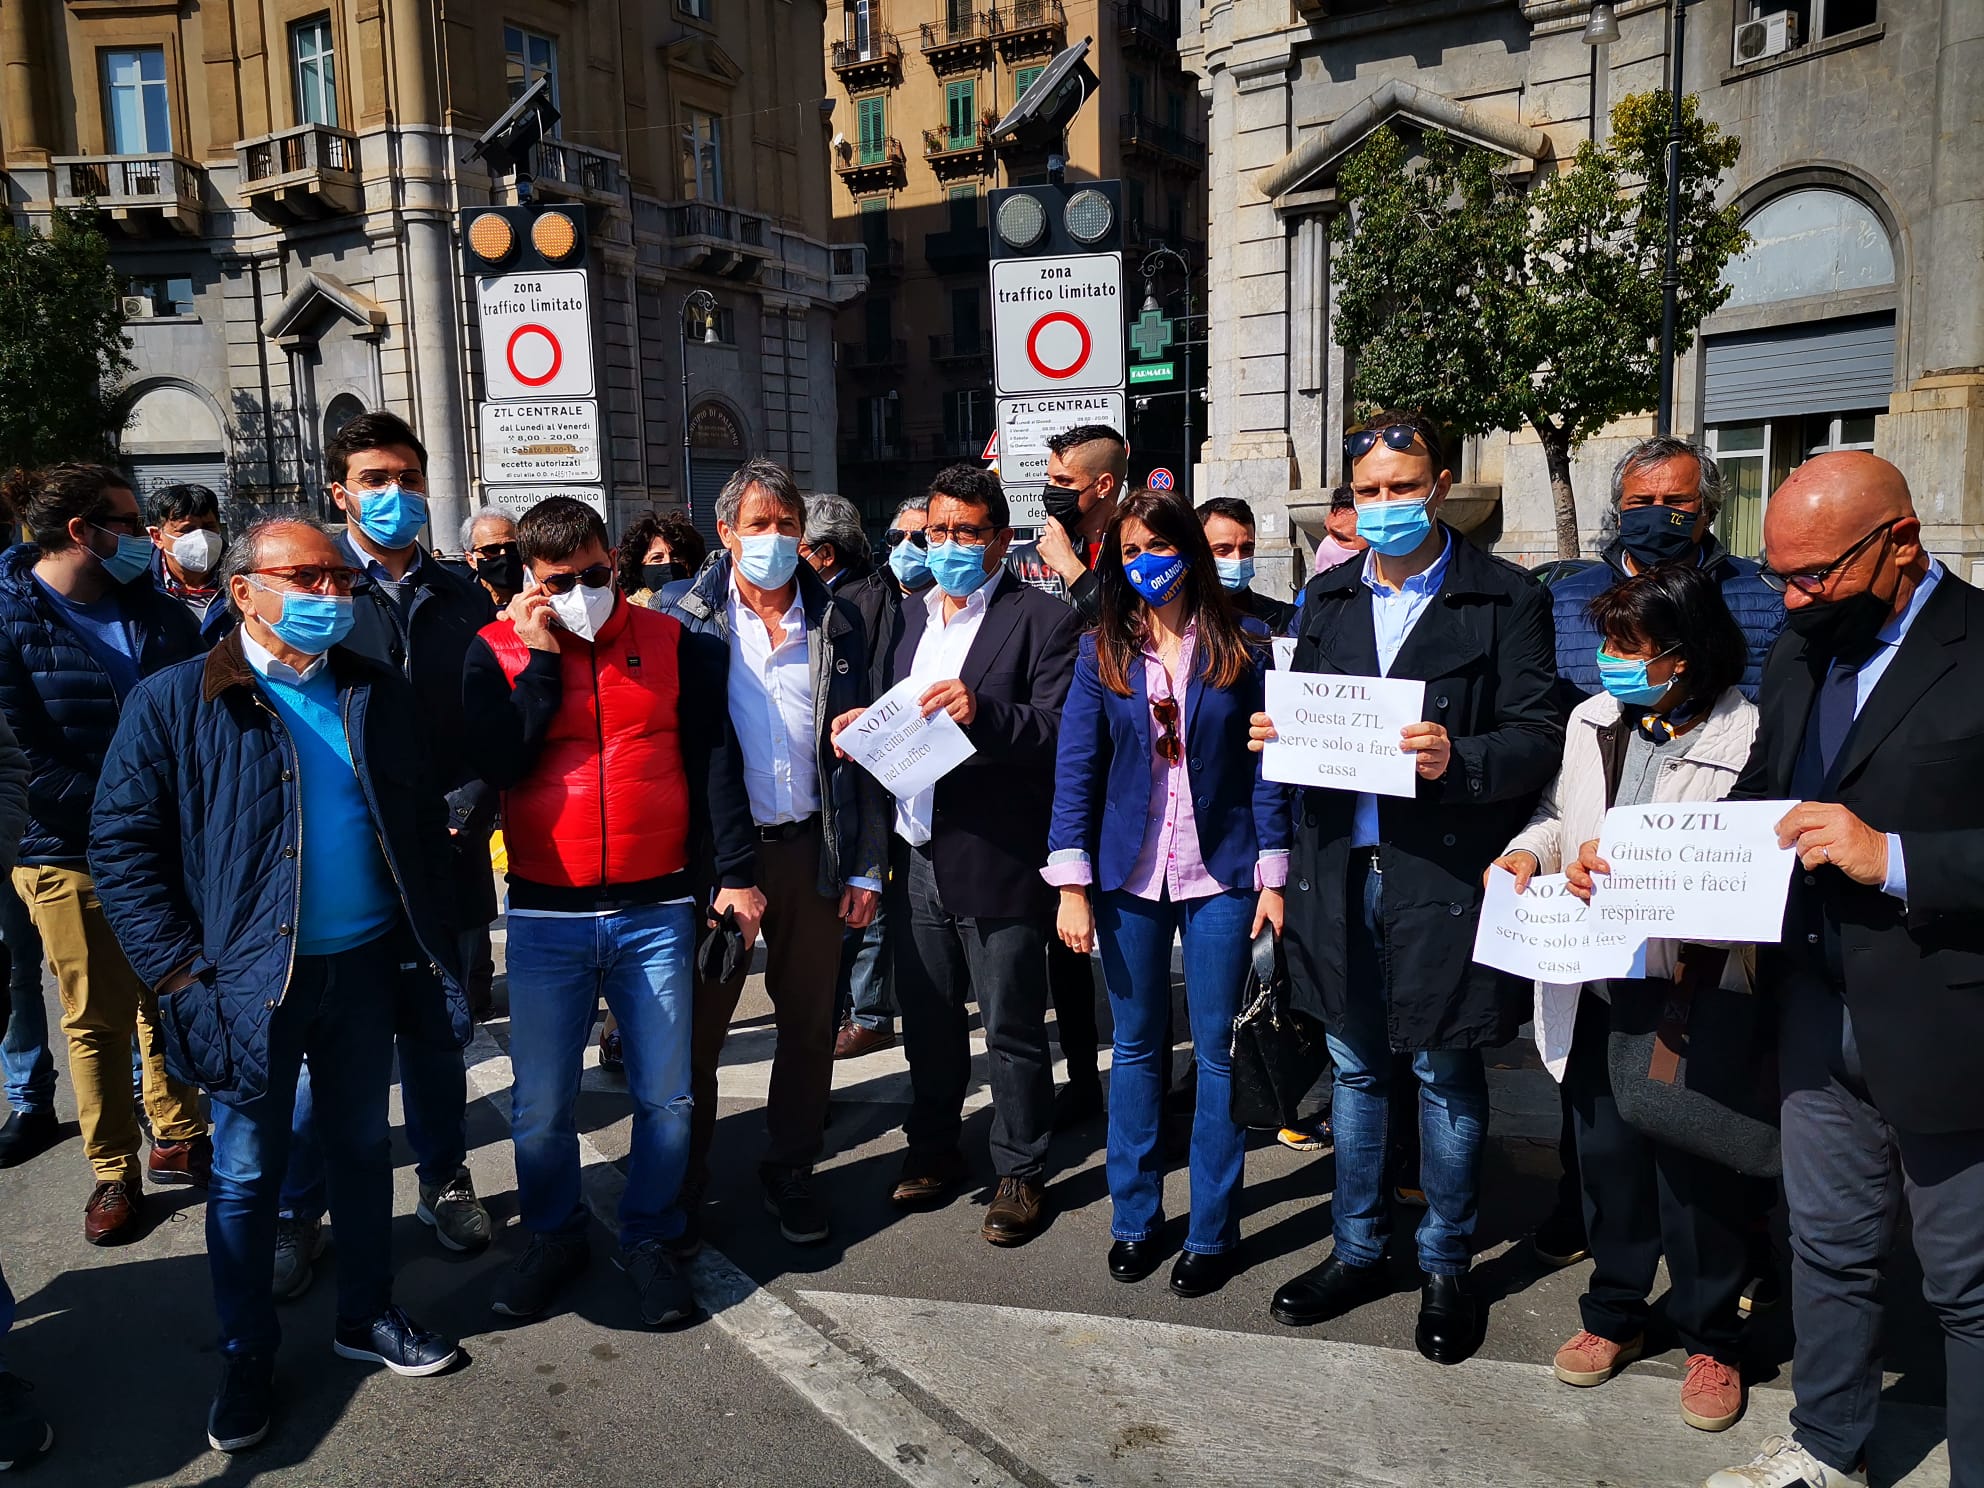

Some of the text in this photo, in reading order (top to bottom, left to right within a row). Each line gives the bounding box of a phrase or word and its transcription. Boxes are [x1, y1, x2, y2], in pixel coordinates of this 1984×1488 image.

[1040, 267, 1072, 280] zona
[513, 282, 542, 293] zona
[999, 282, 1116, 303] traffico limitato
[483, 297, 583, 316] traffico limitato
[1131, 368, 1171, 378] FARMACIA
[494, 406, 583, 417] ZTL CENTRALE
[1011, 398, 1109, 414] ZTL CENTRALE
[500, 424, 513, 432] dal
[547, 423, 555, 431] al
[501, 459, 581, 468] eccetto autorizzati
[1020, 459, 1050, 467] eccett
[498, 493, 541, 503] controllo
[1009, 493, 1044, 503] contro
[1027, 507, 1048, 520] deg
[1150, 559, 1183, 590] ORLANDO
[1303, 682, 1371, 701] NO ZTL
[857, 700, 904, 739] NO ZTL
[906, 713, 932, 738] muor
[1295, 708, 1384, 730] Questa ZTL
[1280, 735, 1398, 757] serve solo a fare
[883, 743, 932, 783] nel traffico
[1318, 762, 1357, 777] cassa
[1639, 813, 1728, 831] NO ZTL
[1611, 841, 1752, 863] Giusto Catania
[1602, 869, 1747, 892] dimettiti e facci
[1525, 884, 1554, 898] NO
[1514, 908, 1570, 923] Questa
[1600, 899, 1675, 924] respirare
[1496, 925, 1627, 948] serve solo a fare
[1537, 960, 1581, 973] cassa
